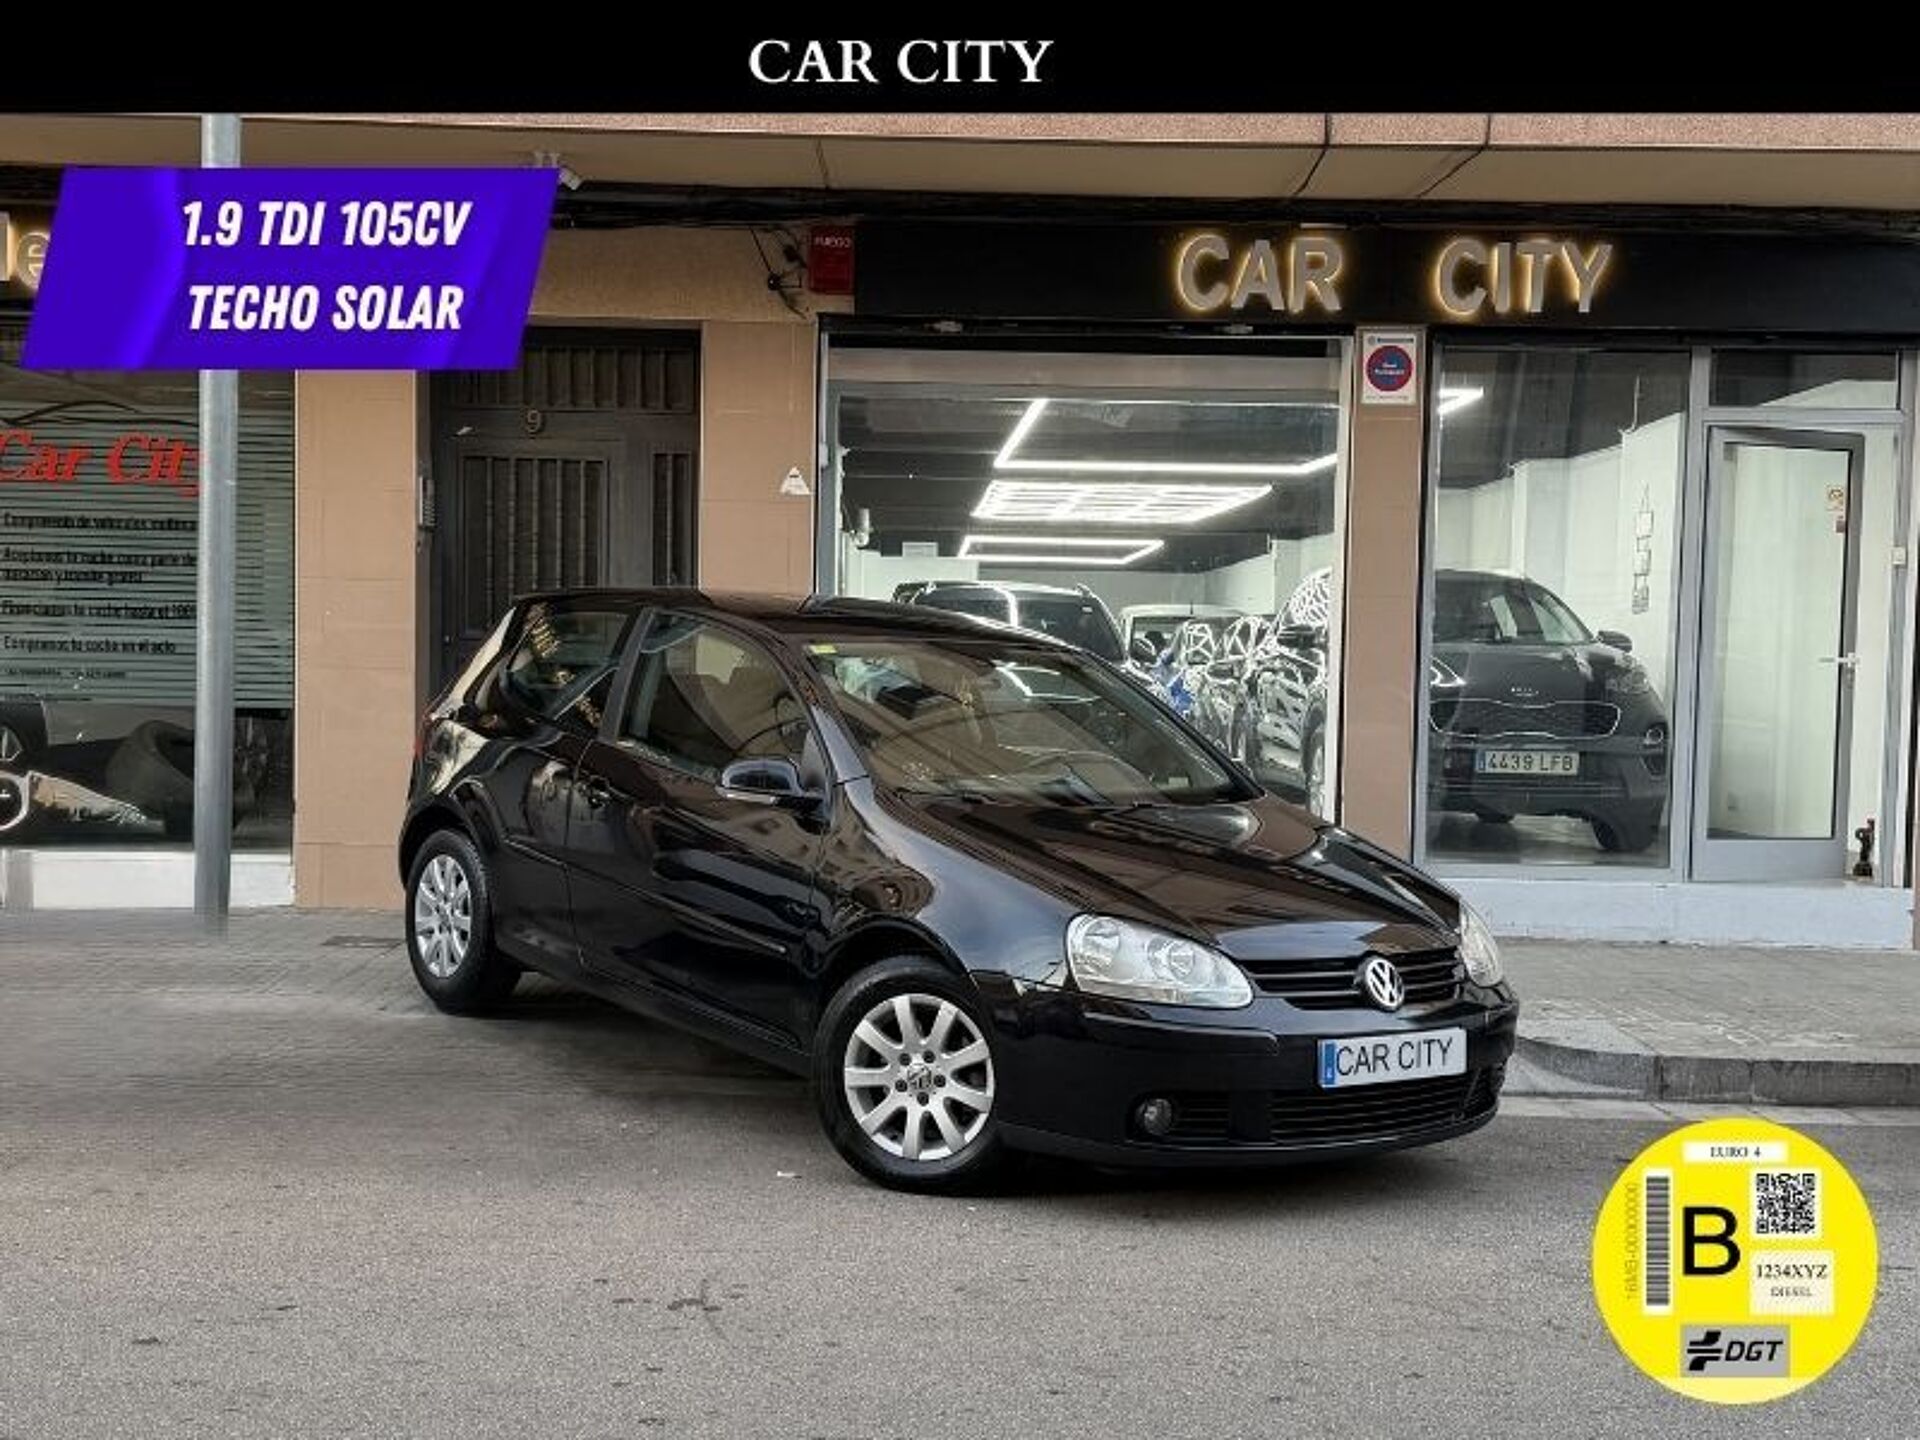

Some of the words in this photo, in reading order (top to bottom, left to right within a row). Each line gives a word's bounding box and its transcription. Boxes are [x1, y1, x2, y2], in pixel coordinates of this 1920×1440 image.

[1177, 234, 1343, 313] CAR
[1433, 236, 1613, 315] CITY
[525, 409, 544, 433] 9
[0, 429, 91, 482] Car
[1488, 753, 1534, 771] 4439
[1336, 1042, 1390, 1076] CAR
[1398, 1037, 1452, 1069] CITY
